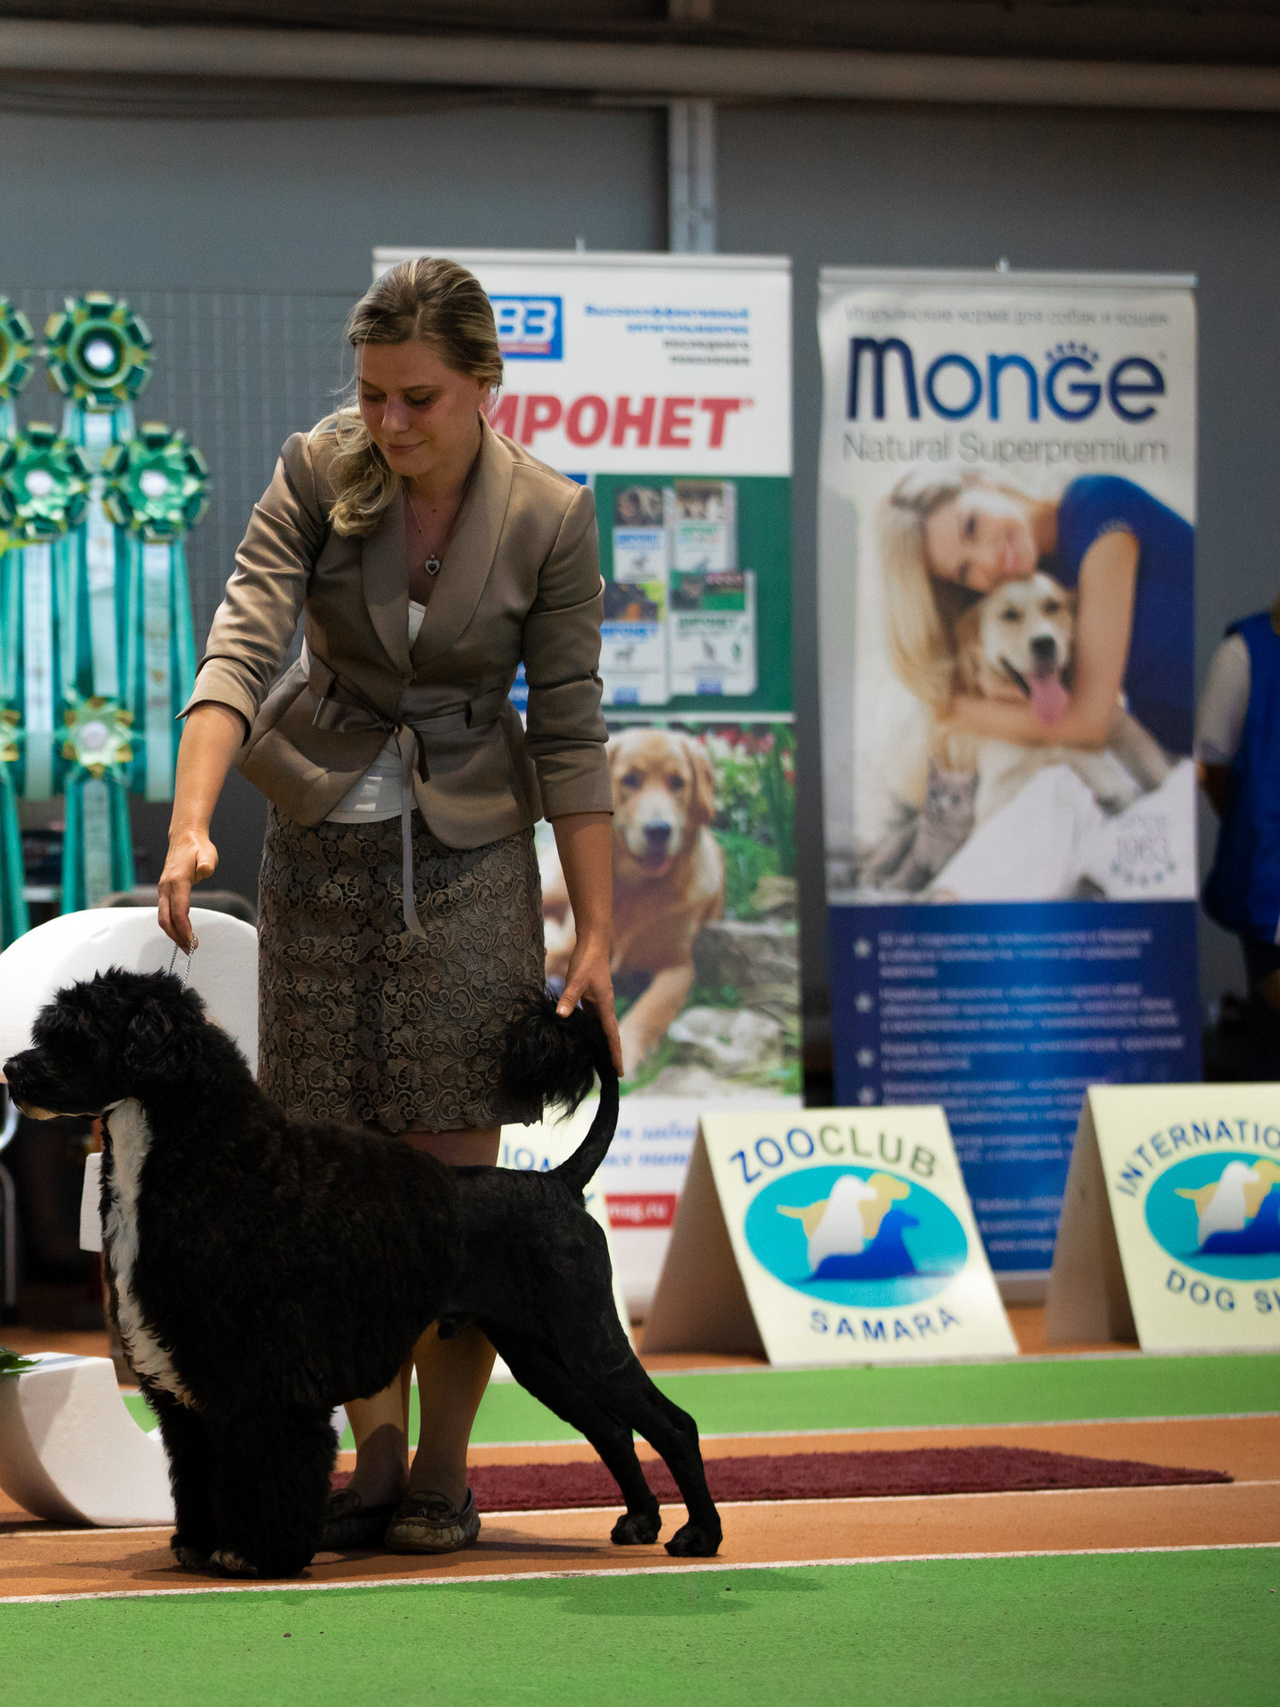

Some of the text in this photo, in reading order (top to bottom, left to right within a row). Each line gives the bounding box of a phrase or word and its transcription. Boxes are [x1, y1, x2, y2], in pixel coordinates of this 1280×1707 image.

[842, 431, 1168, 466] Natural Superpremium
[729, 1123, 937, 1185] ZOOCLUB
[1166, 1269, 1236, 1312] DOG
[809, 1307, 962, 1342] SAMARA
